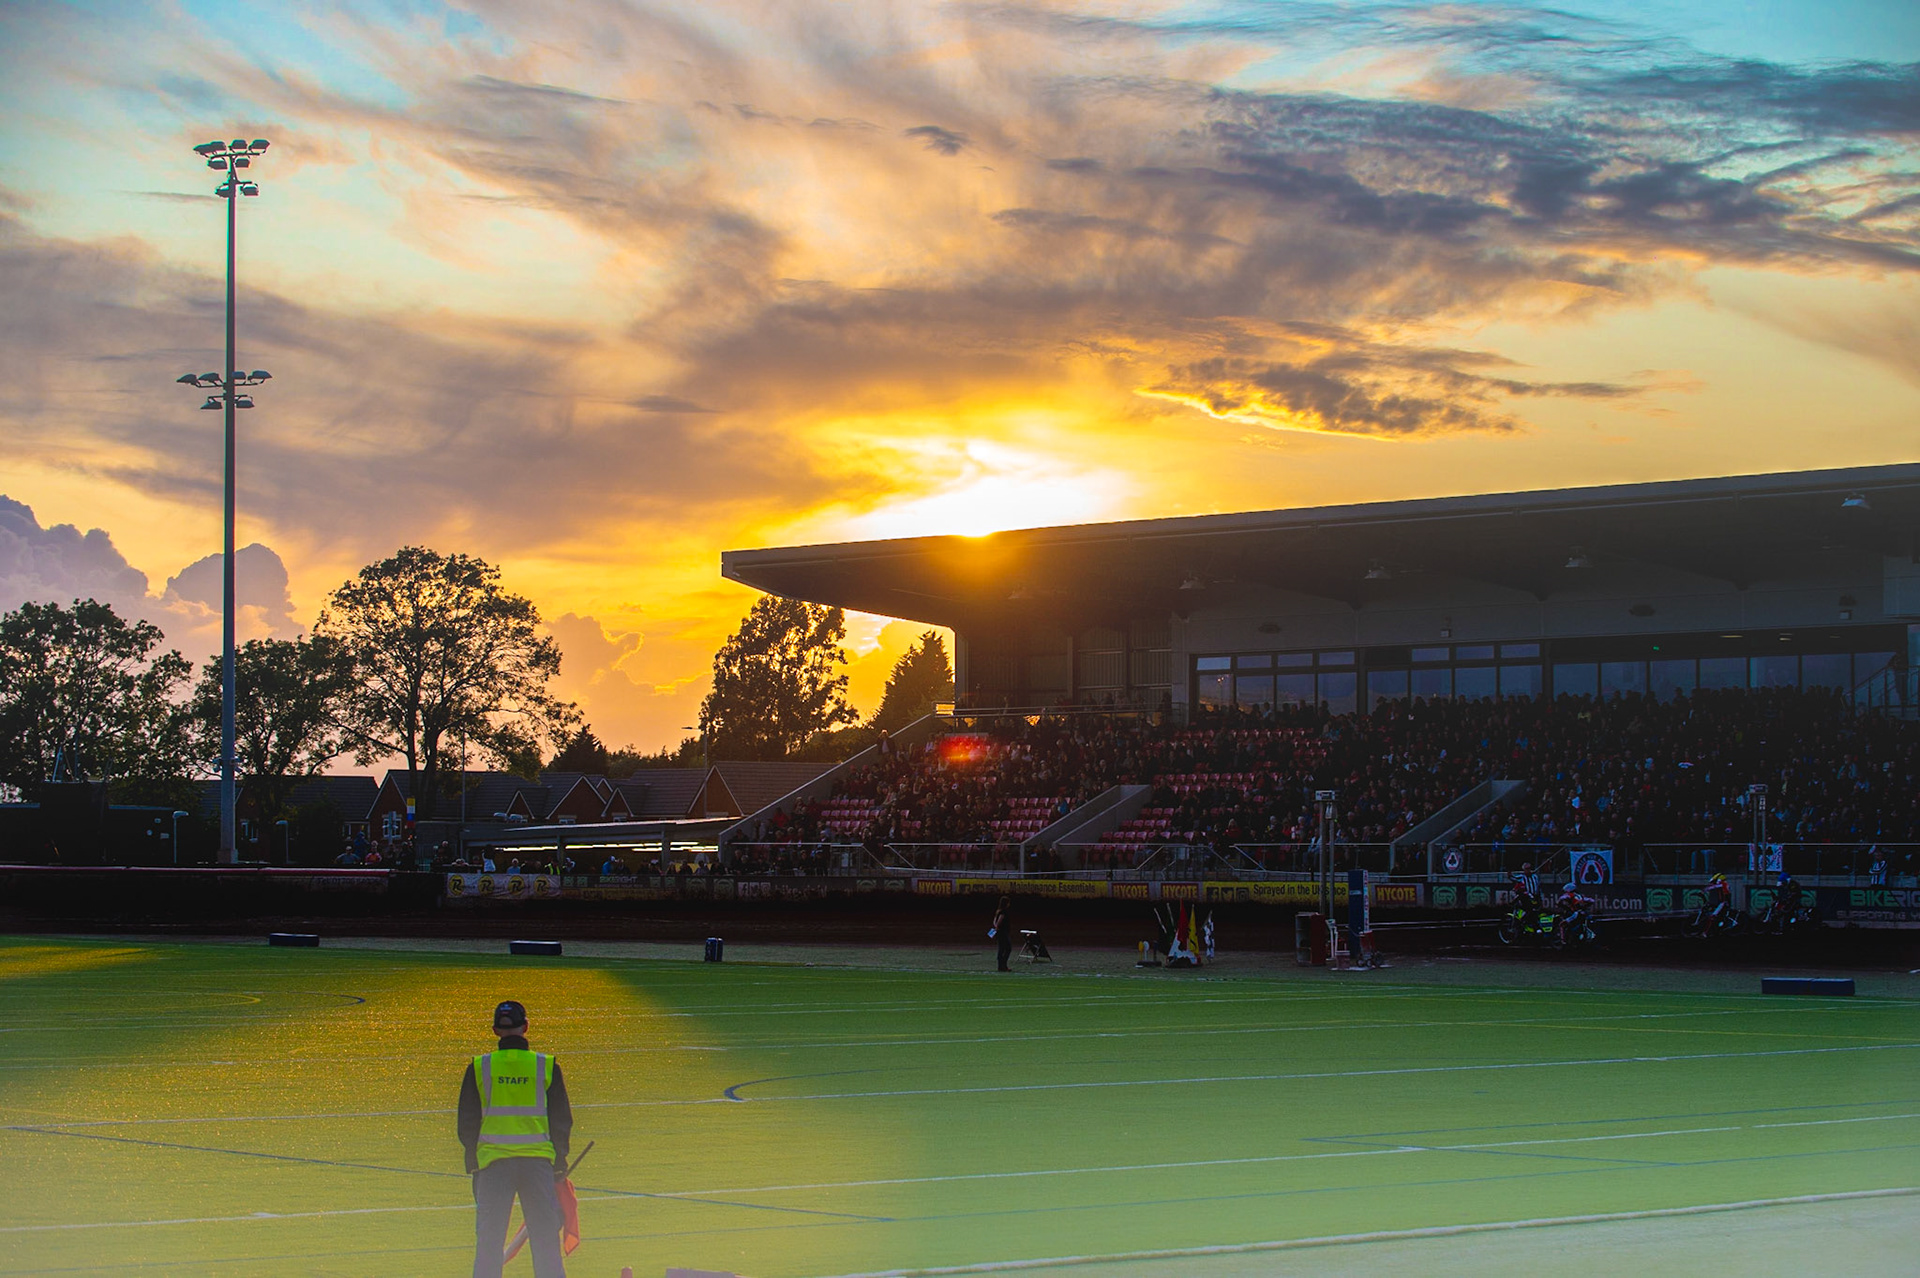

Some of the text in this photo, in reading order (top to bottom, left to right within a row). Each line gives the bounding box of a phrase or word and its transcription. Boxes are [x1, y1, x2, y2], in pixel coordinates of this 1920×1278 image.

[1009, 881, 1096, 894] Maintenance Essentials
[1113, 884, 1148, 898] HYCOTE
[1162, 884, 1198, 898] HYCOTE
[1253, 884, 1286, 896] Sprayed
[1287, 884, 1296, 895] in
[1297, 884, 1310, 895] the
[1324, 885, 1346, 896] sce
[1375, 887, 1416, 901] HYCOTE
[1542, 893, 1643, 910] biht.com
[498, 1076, 529, 1084] STAFF
